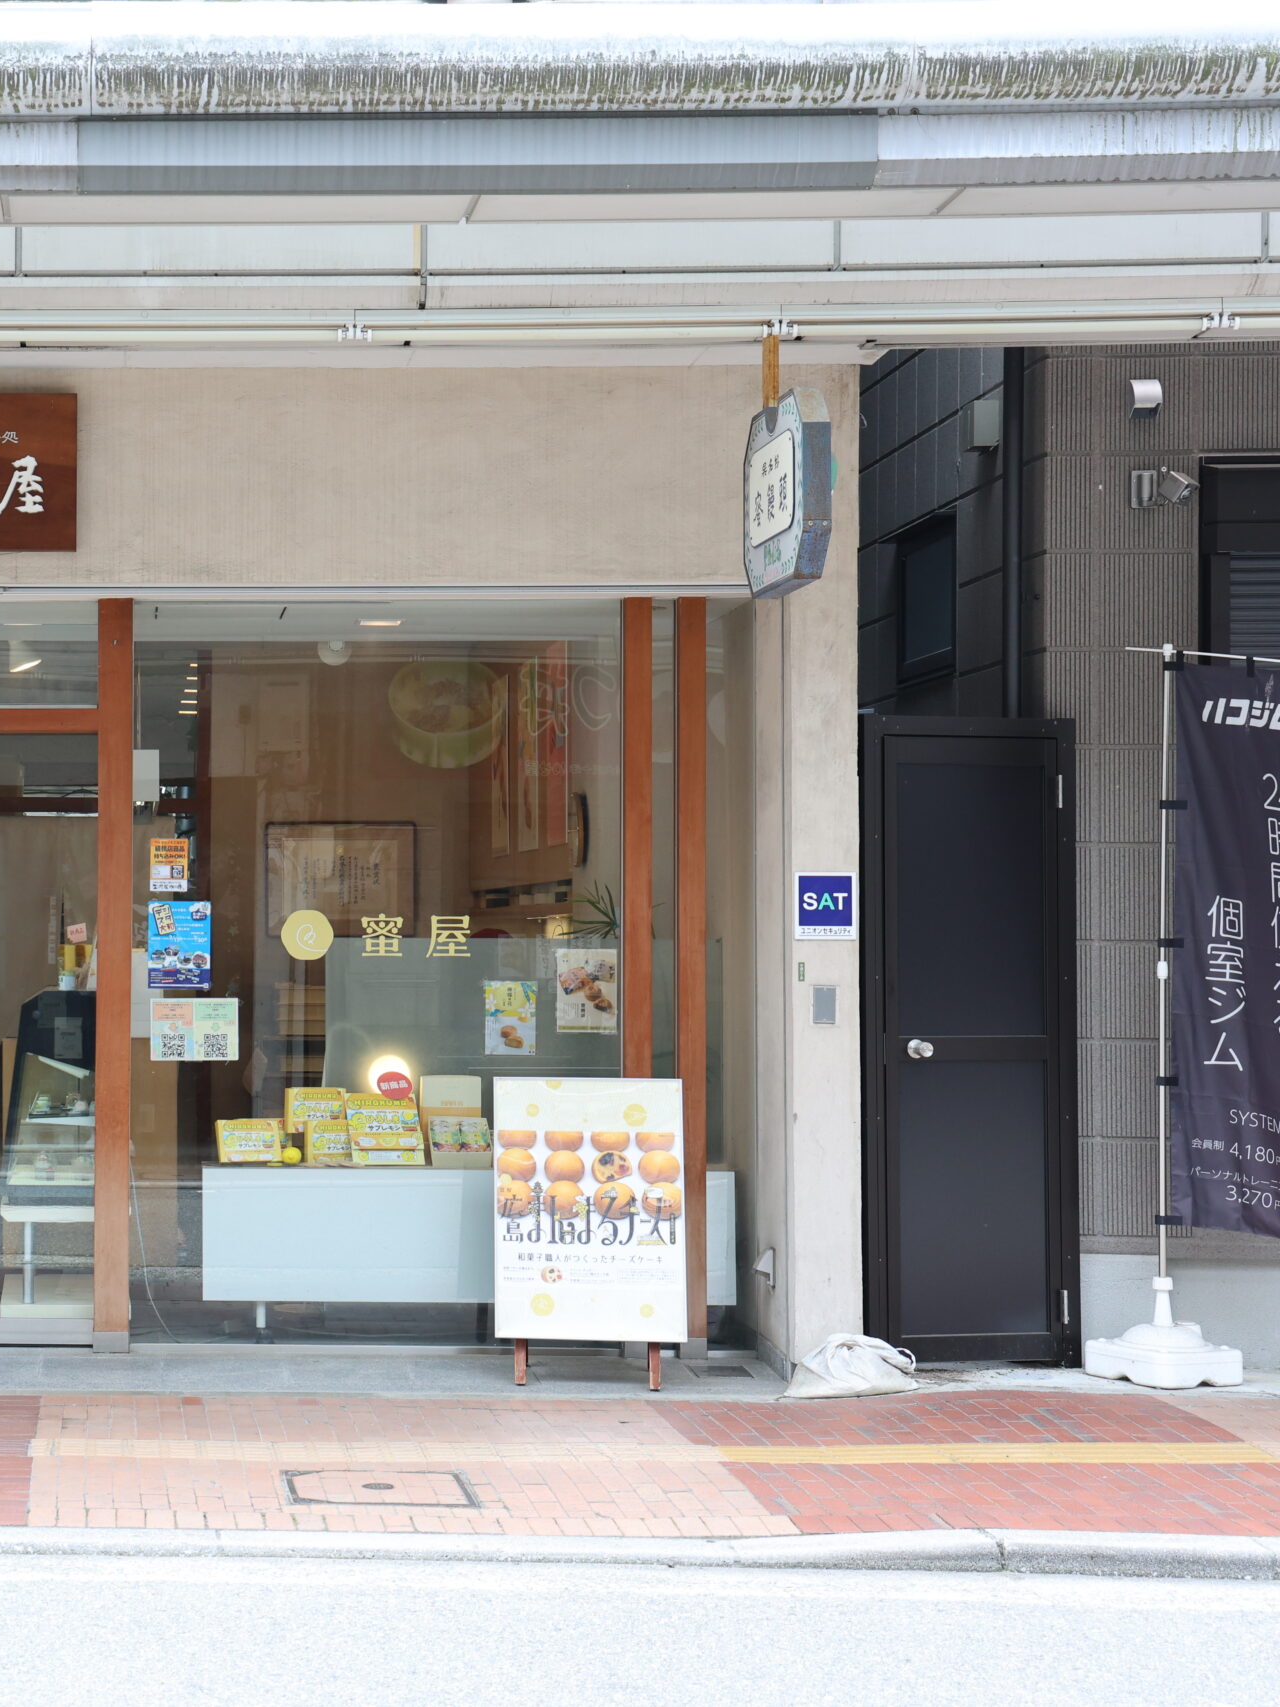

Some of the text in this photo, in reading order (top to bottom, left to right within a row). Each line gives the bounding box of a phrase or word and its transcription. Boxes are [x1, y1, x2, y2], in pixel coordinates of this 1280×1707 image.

[802, 892, 848, 911] SAT
[360, 913, 471, 958] 蜜屋
[800, 927, 851, 935] ユニオンセキュリティ
[1203, 895, 1246, 1072] 個室ジム
[367, 1124, 401, 1132] サブレモン
[1191, 1138, 1225, 1151] 会員制
[1190, 1166, 1280, 1191] パーソナルトレーニ
[517, 1253, 664, 1264] 和菓子職人がつくったチーズケーキ
